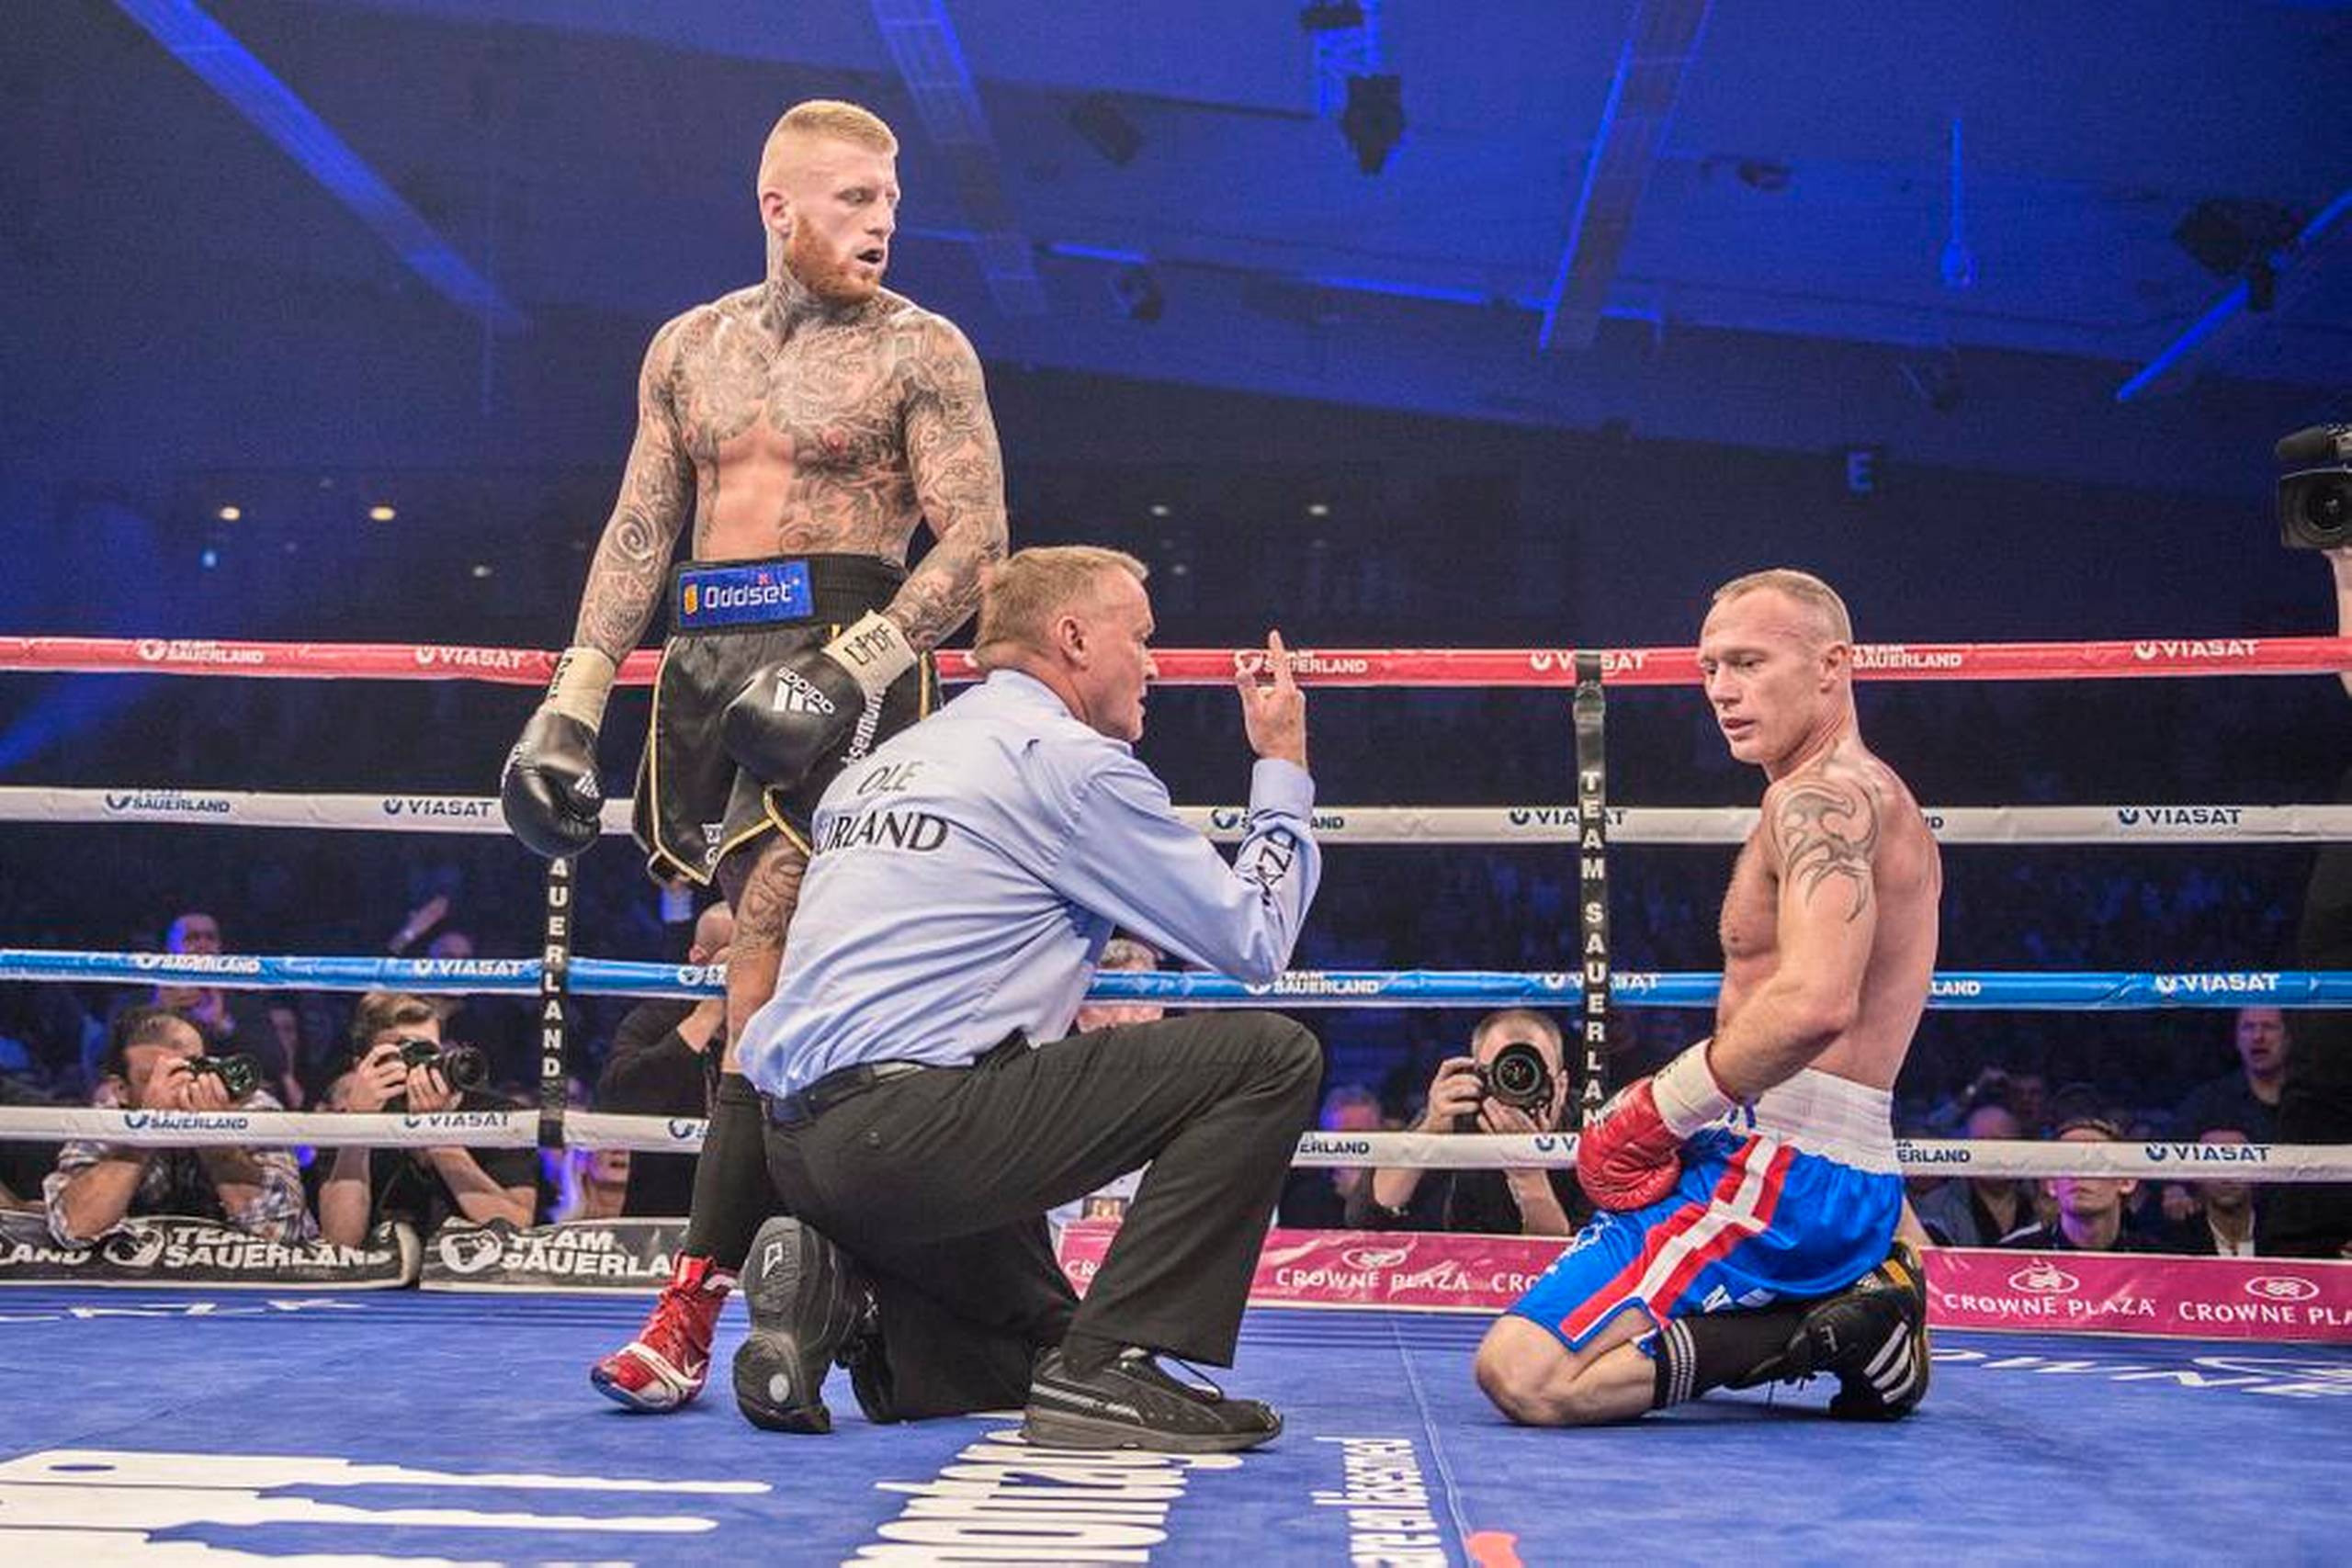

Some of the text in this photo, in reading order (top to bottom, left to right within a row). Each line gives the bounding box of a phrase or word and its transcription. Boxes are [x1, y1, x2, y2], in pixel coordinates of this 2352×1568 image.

[704, 583, 792, 609] Oddset
[2161, 639, 2260, 658] VIASAT
[439, 647, 525, 669] VIASAT
[1264, 658, 1368, 673] SERLAND
[1556, 653, 1645, 670] VSAT
[1852, 653, 1963, 668] SAUERLAND
[856, 761, 923, 796] OLE
[132, 797, 231, 813] SAUERLAND
[408, 799, 494, 817] VIASAT
[1536, 810, 1627, 825] VIAAT
[2145, 808, 2243, 825] VIASAT
[1580, 771, 1606, 1129] TEAM SAUERLAN
[437, 959, 523, 976] VIASAT
[1570, 974, 1660, 989] VSAT
[2181, 973, 2280, 992] VIASAT
[1300, 1140, 1371, 1155] ERLAND
[1896, 1148, 1972, 1163] ERLAND
[2173, 1145, 2271, 1161] VIASAT
[508, 1230, 616, 1252] TEAM
[499, 1252, 675, 1277] SAUERLA
[1276, 1268, 1470, 1291] CROWNE PLAZA
[1942, 1293, 2156, 1317] CROWNE PLAZA
[2178, 1301, 2297, 1324] CROWNE
